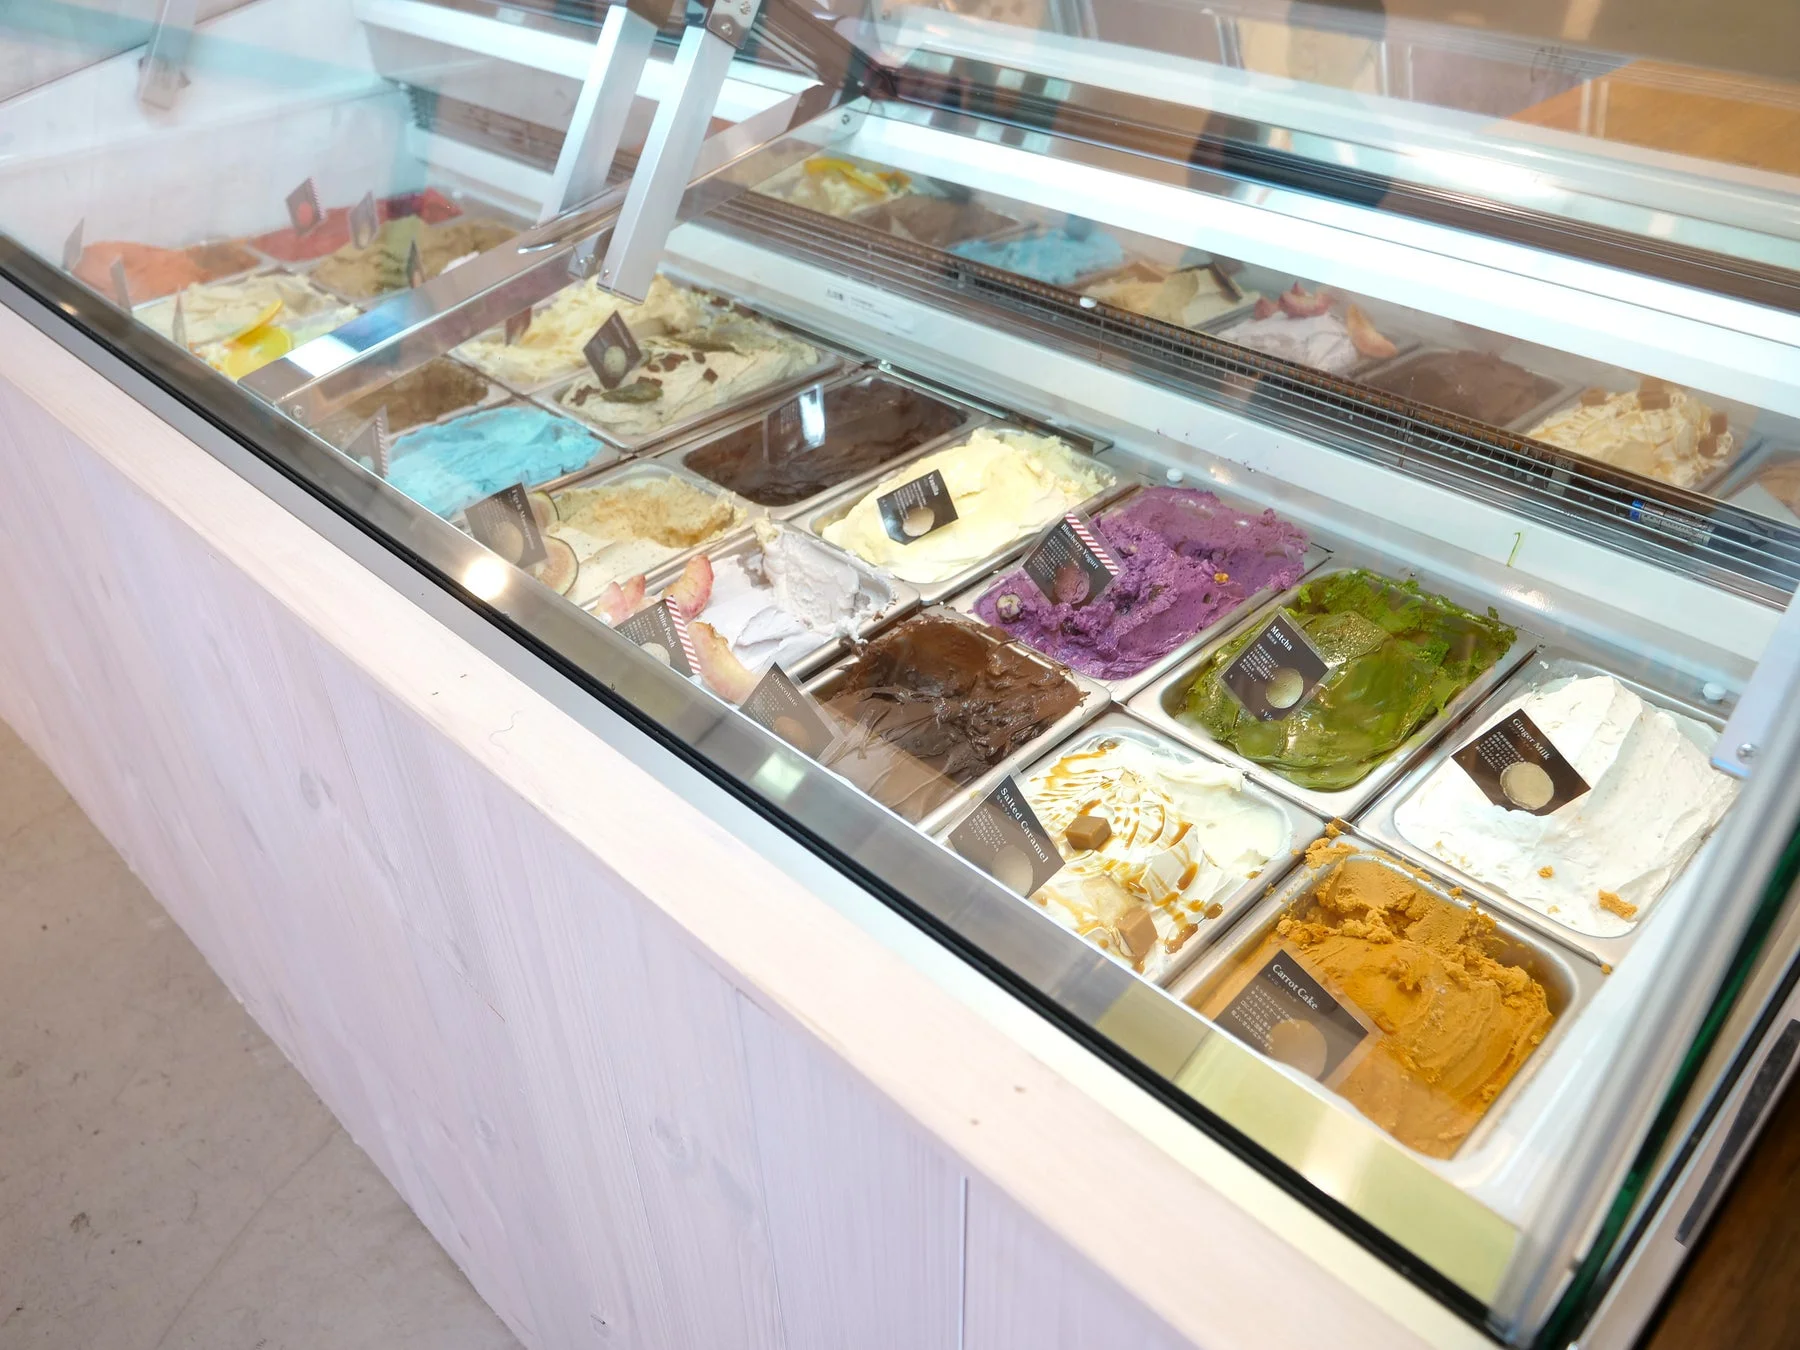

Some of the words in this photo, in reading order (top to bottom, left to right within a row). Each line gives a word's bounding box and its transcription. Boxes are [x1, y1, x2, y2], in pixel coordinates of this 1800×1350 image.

[1061, 524, 1082, 551] Blueberry
[1082, 548, 1099, 569] Yogurt
[656, 606, 667, 628] White
[665, 626, 677, 648] Peach
[1271, 625, 1293, 652] Matcha
[771, 673, 798, 707] Chocolate
[1512, 718, 1535, 743] Ginger
[1533, 742, 1551, 760] Milk
[1000, 787, 1023, 820] Salted
[1020, 820, 1049, 863] Caramel
[1272, 964, 1299, 991] Carrot
[1297, 988, 1319, 1010] Cake
